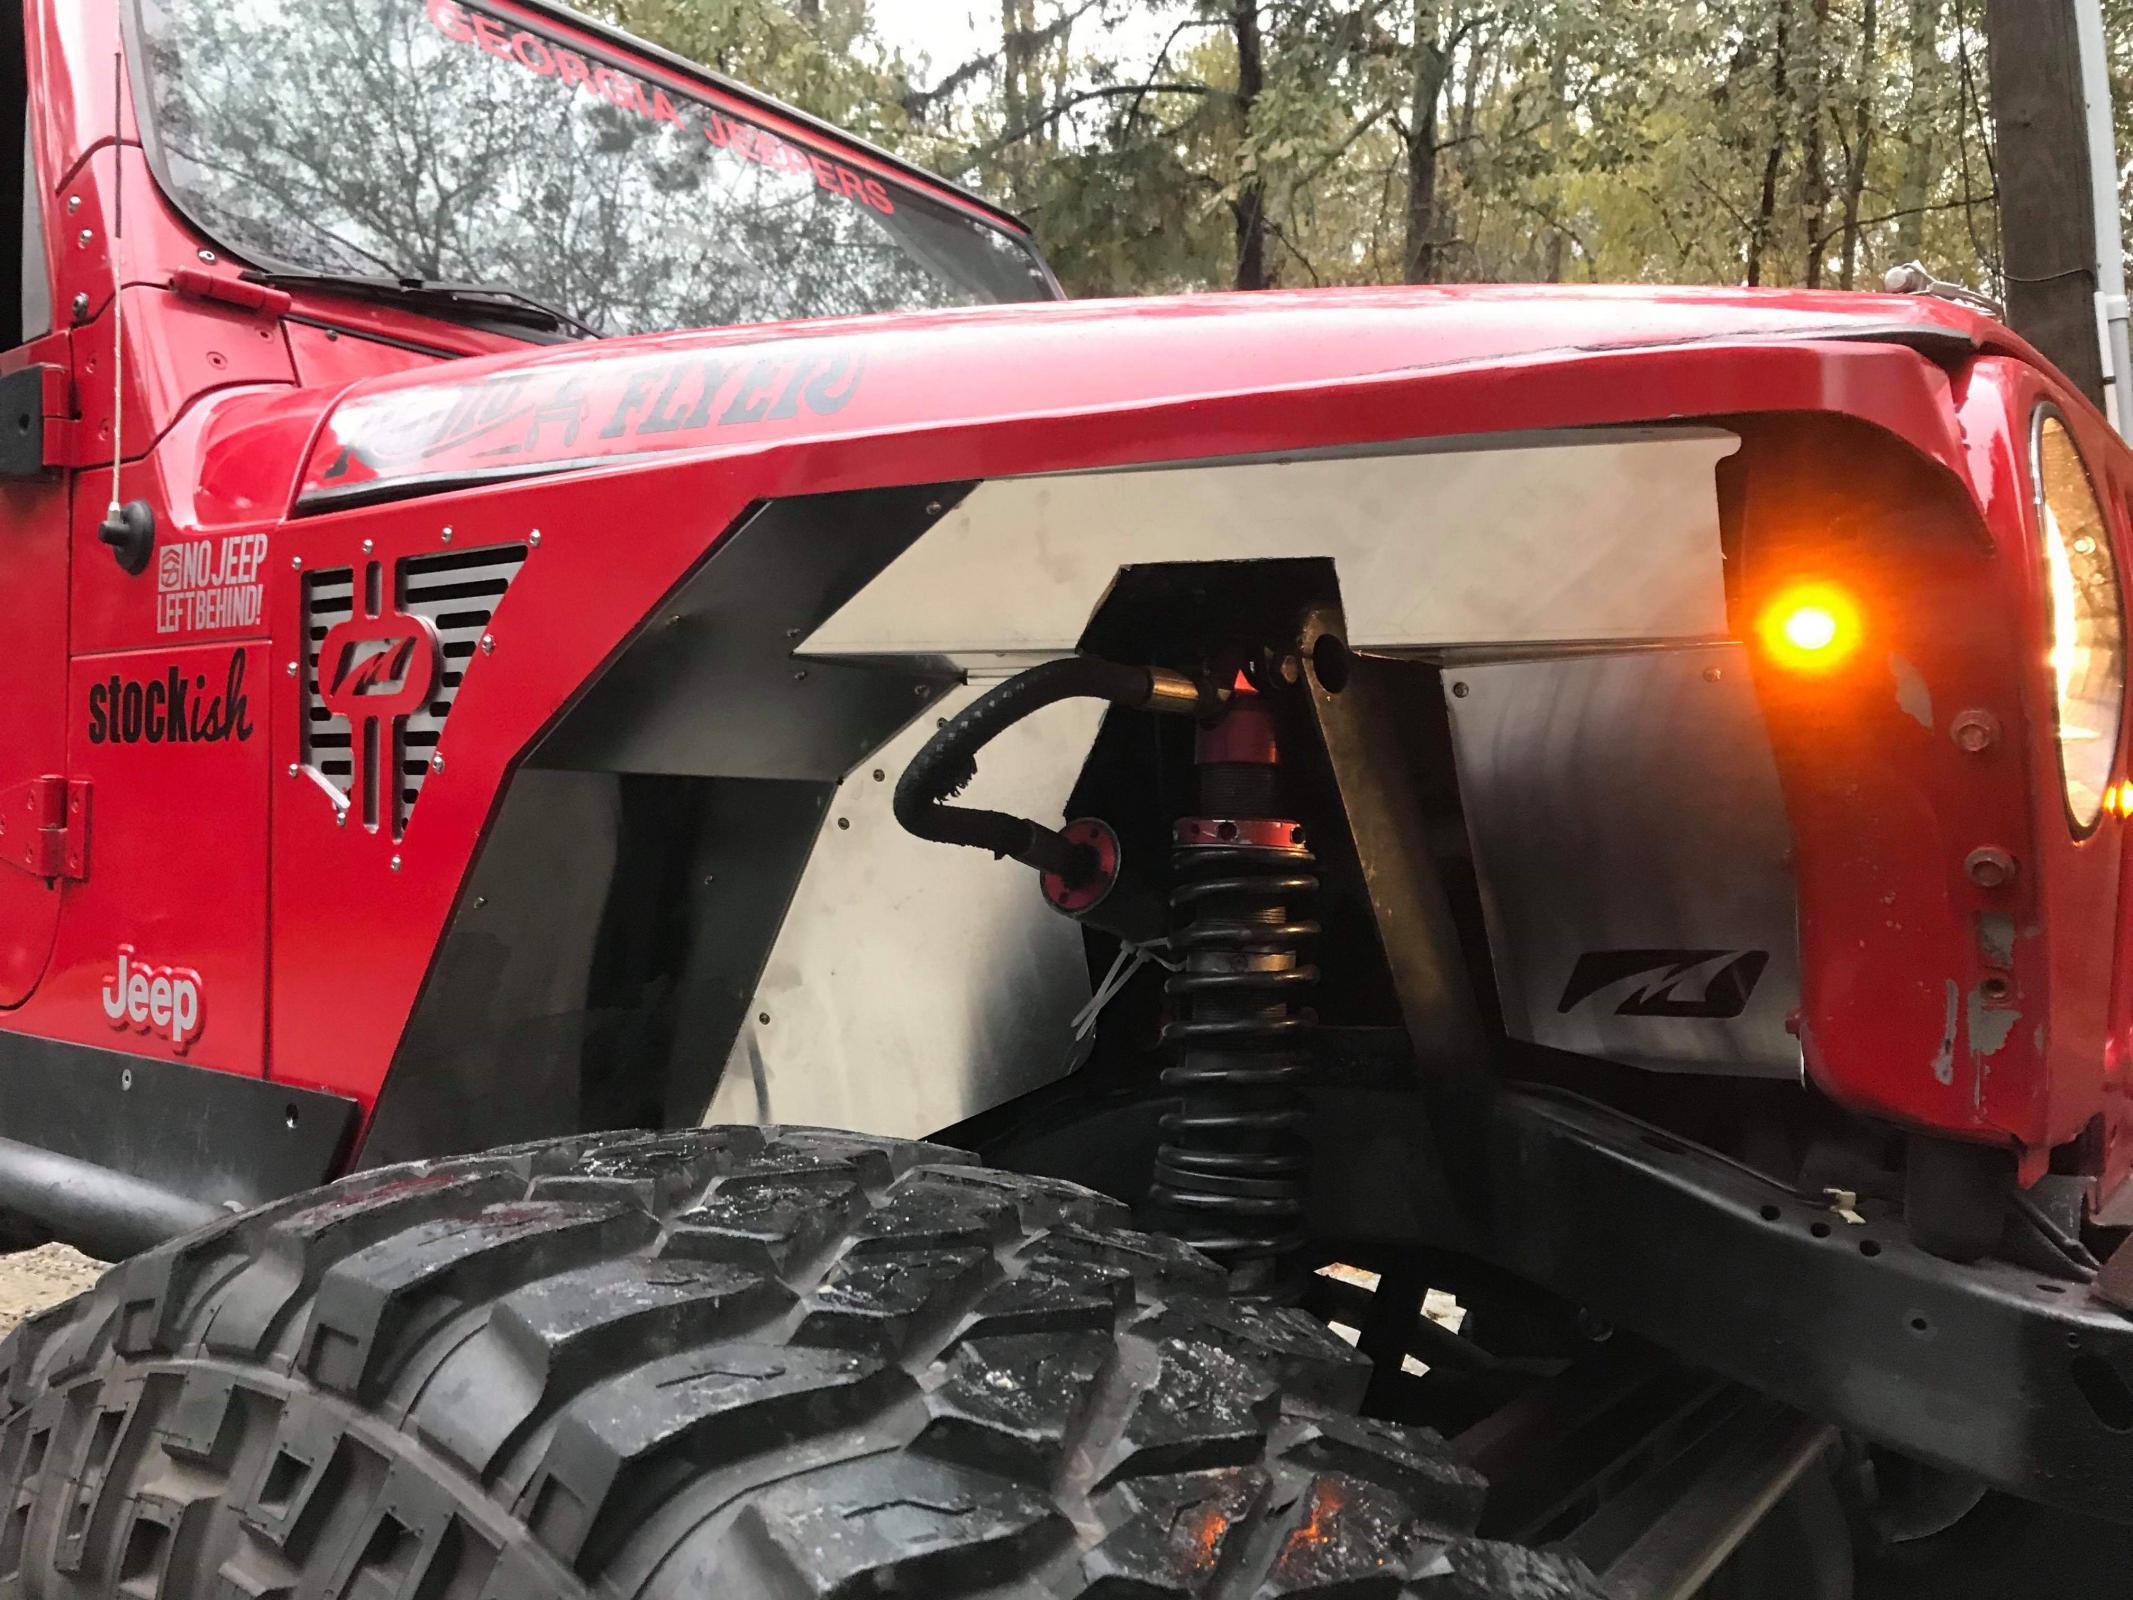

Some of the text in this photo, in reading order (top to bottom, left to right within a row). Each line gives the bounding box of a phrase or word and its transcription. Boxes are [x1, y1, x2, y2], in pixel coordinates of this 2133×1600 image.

[426, 0, 895, 215] GEORGIA JEEPERS
[183, 533, 268, 589] NO JEEP
[157, 584, 264, 634] LEFT BEHIND!
[89, 647, 254, 743] stockish
[102, 954, 198, 1042] Jeep
